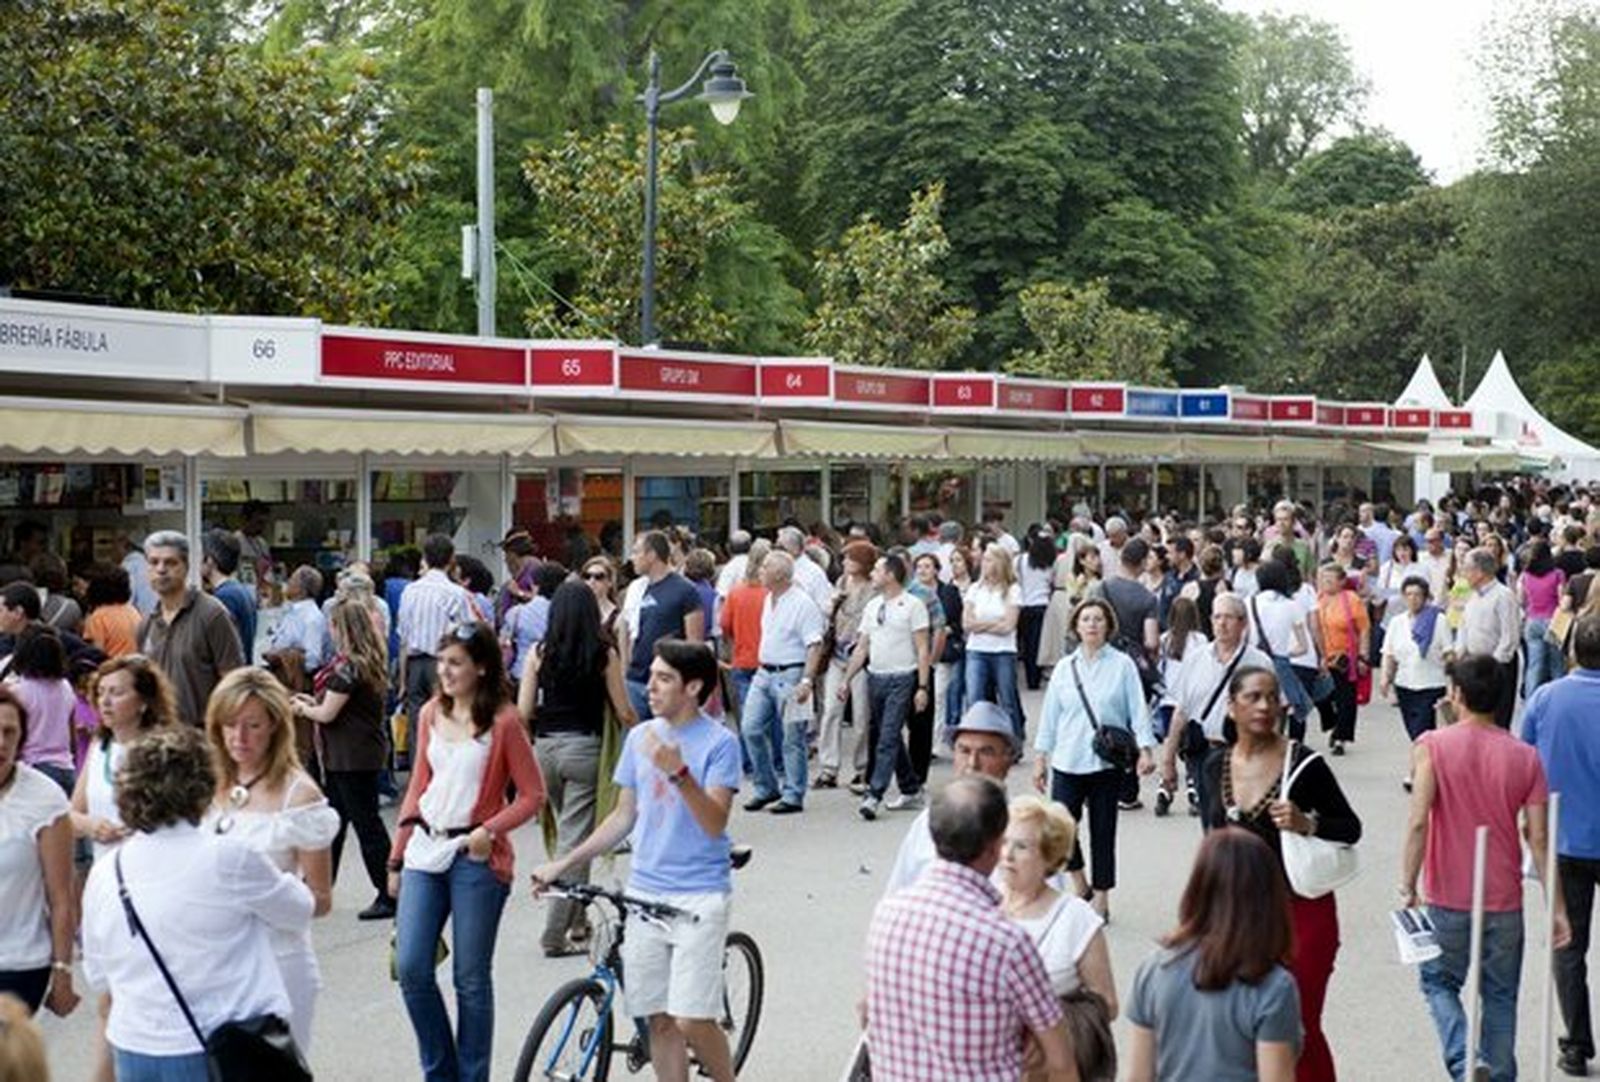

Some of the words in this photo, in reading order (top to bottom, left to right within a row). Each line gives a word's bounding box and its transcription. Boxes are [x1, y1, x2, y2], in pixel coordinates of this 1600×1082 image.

[56, 323, 109, 352] FÁBULA
[253, 339, 276, 359] 66
[384, 351, 404, 370] PPC
[405, 351, 456, 373] EDITORIAL
[562, 359, 581, 376] 65
[786, 372, 802, 389] 64
[957, 385, 972, 400] 63
